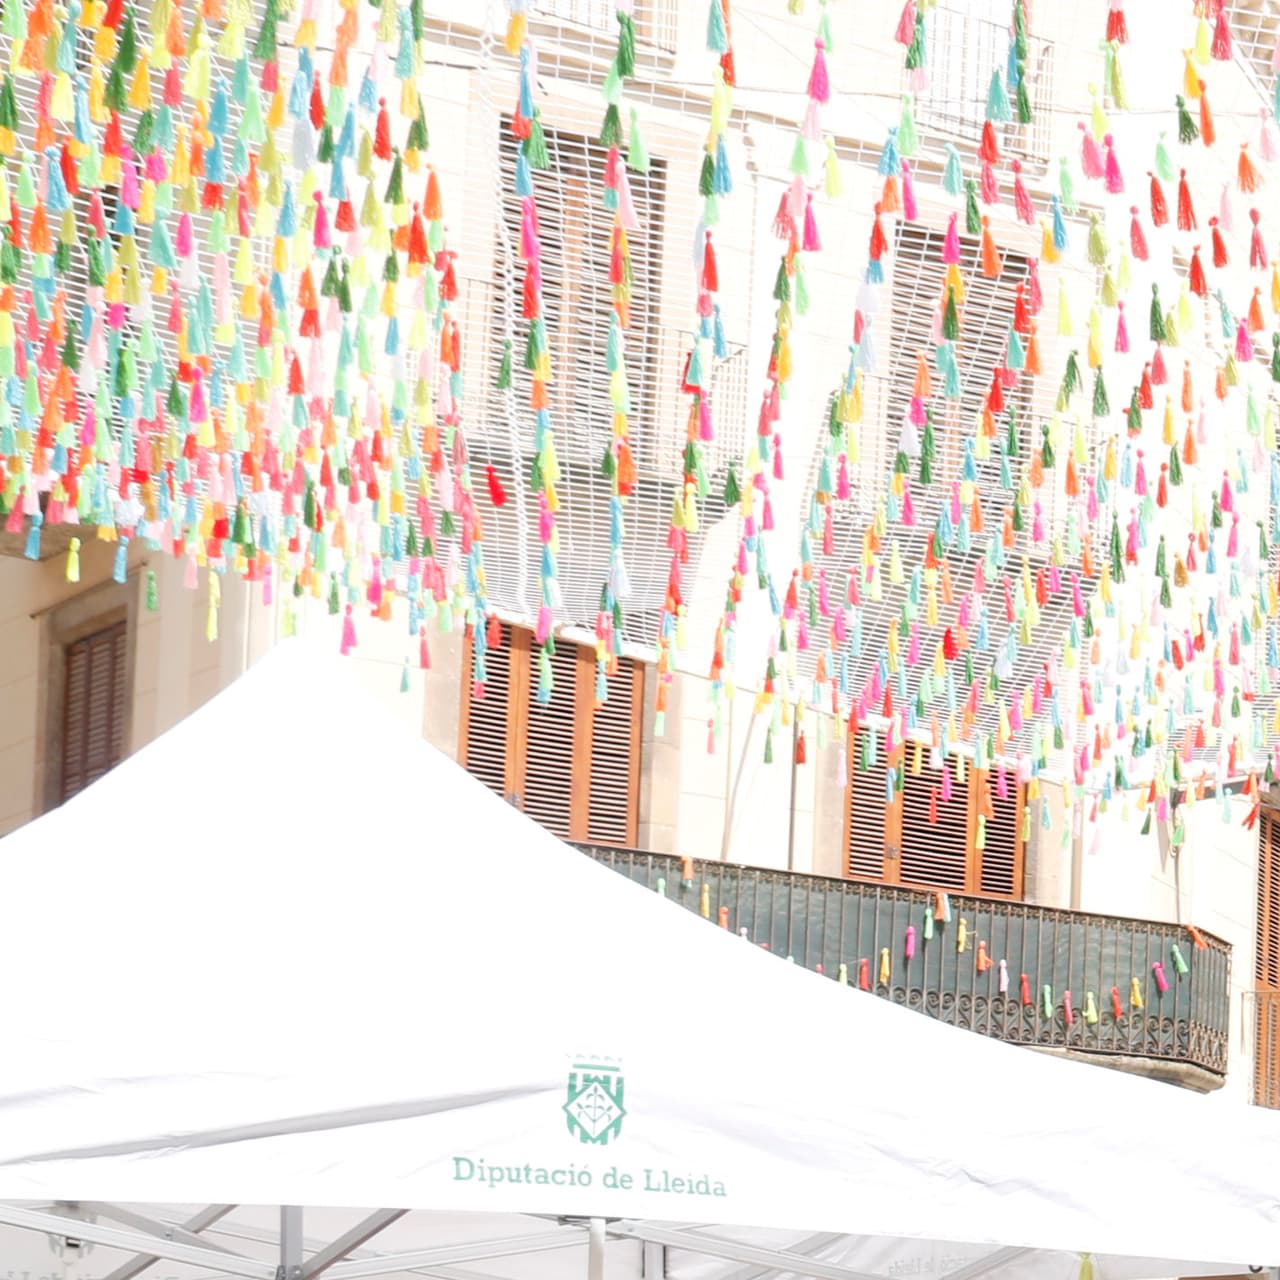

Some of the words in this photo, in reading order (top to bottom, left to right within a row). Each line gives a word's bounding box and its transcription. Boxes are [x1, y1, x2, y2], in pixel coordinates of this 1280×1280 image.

[453, 1156, 593, 1188] Diputació
[602, 1167, 633, 1190] de
[643, 1168, 728, 1198] Lleida
